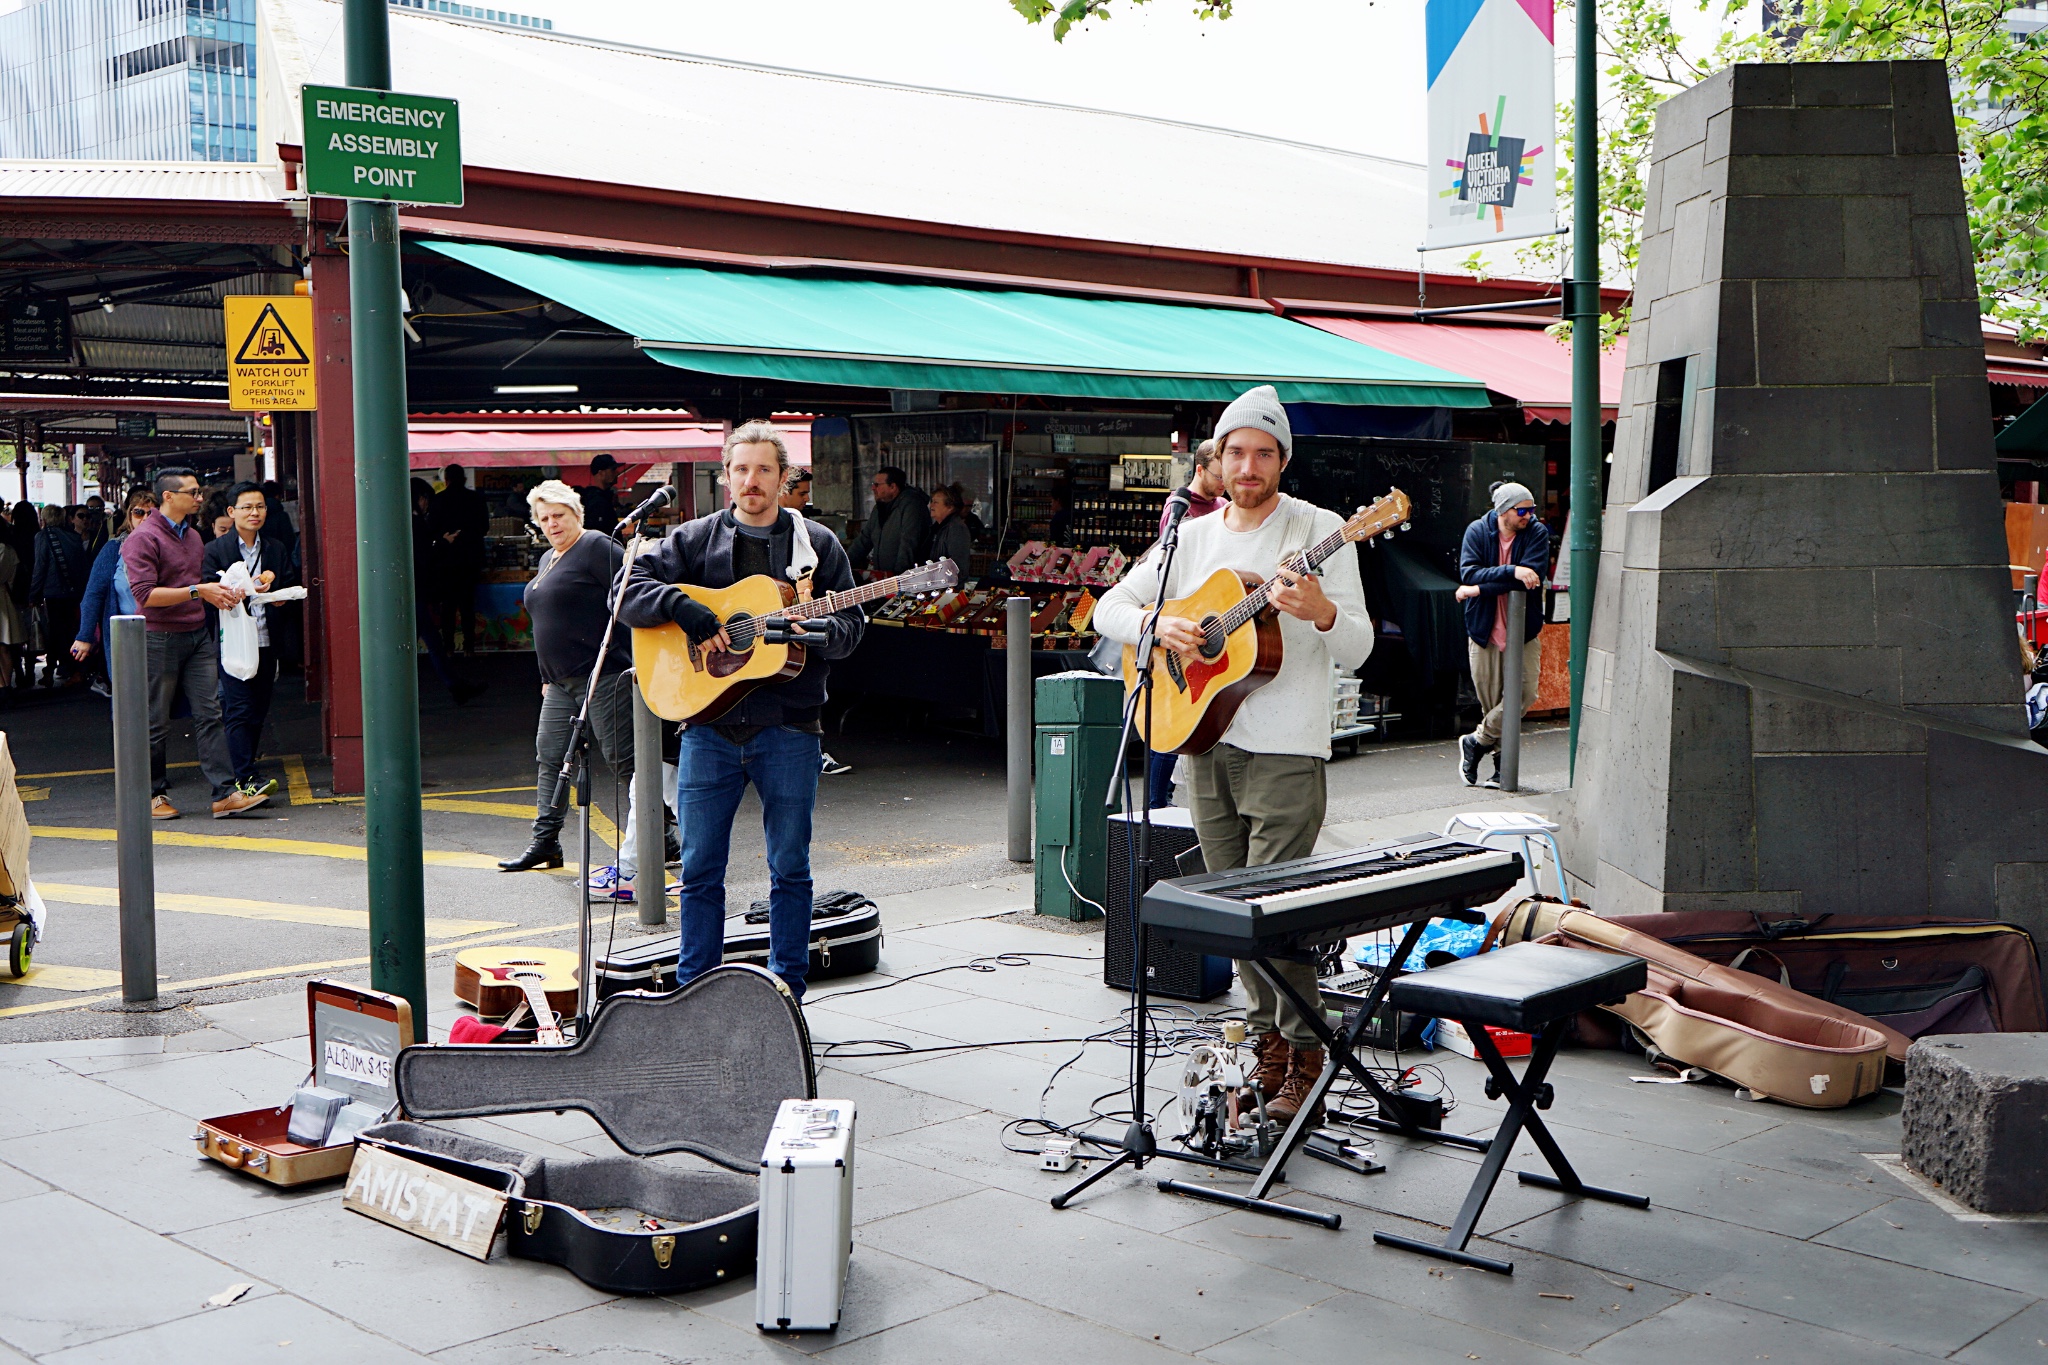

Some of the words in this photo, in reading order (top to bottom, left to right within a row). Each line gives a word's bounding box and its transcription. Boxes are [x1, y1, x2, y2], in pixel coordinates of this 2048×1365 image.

[316, 99, 446, 129] EMERGENCY
[328, 132, 439, 159] ASSEMBLY
[1467, 150, 1498, 171] QUEEN
[353, 165, 417, 188] POINT
[1467, 166, 1511, 188] VICTORIA
[1467, 183, 1506, 204] MARKET
[236, 367, 280, 377] WATCH
[283, 367, 309, 377] OUT
[241, 388, 294, 396] OPERATING
[296, 388, 305, 396] IN
[251, 379, 295, 387] FORKLIFT
[250, 397, 271, 405] THIS
[272, 397, 298, 405] AREA
[1053, 739, 1063, 748] 1A
[324, 1044, 367, 1075] ALBUM
[367, 1056, 389, 1079] $15
[345, 1160, 492, 1242] AMISTAT
